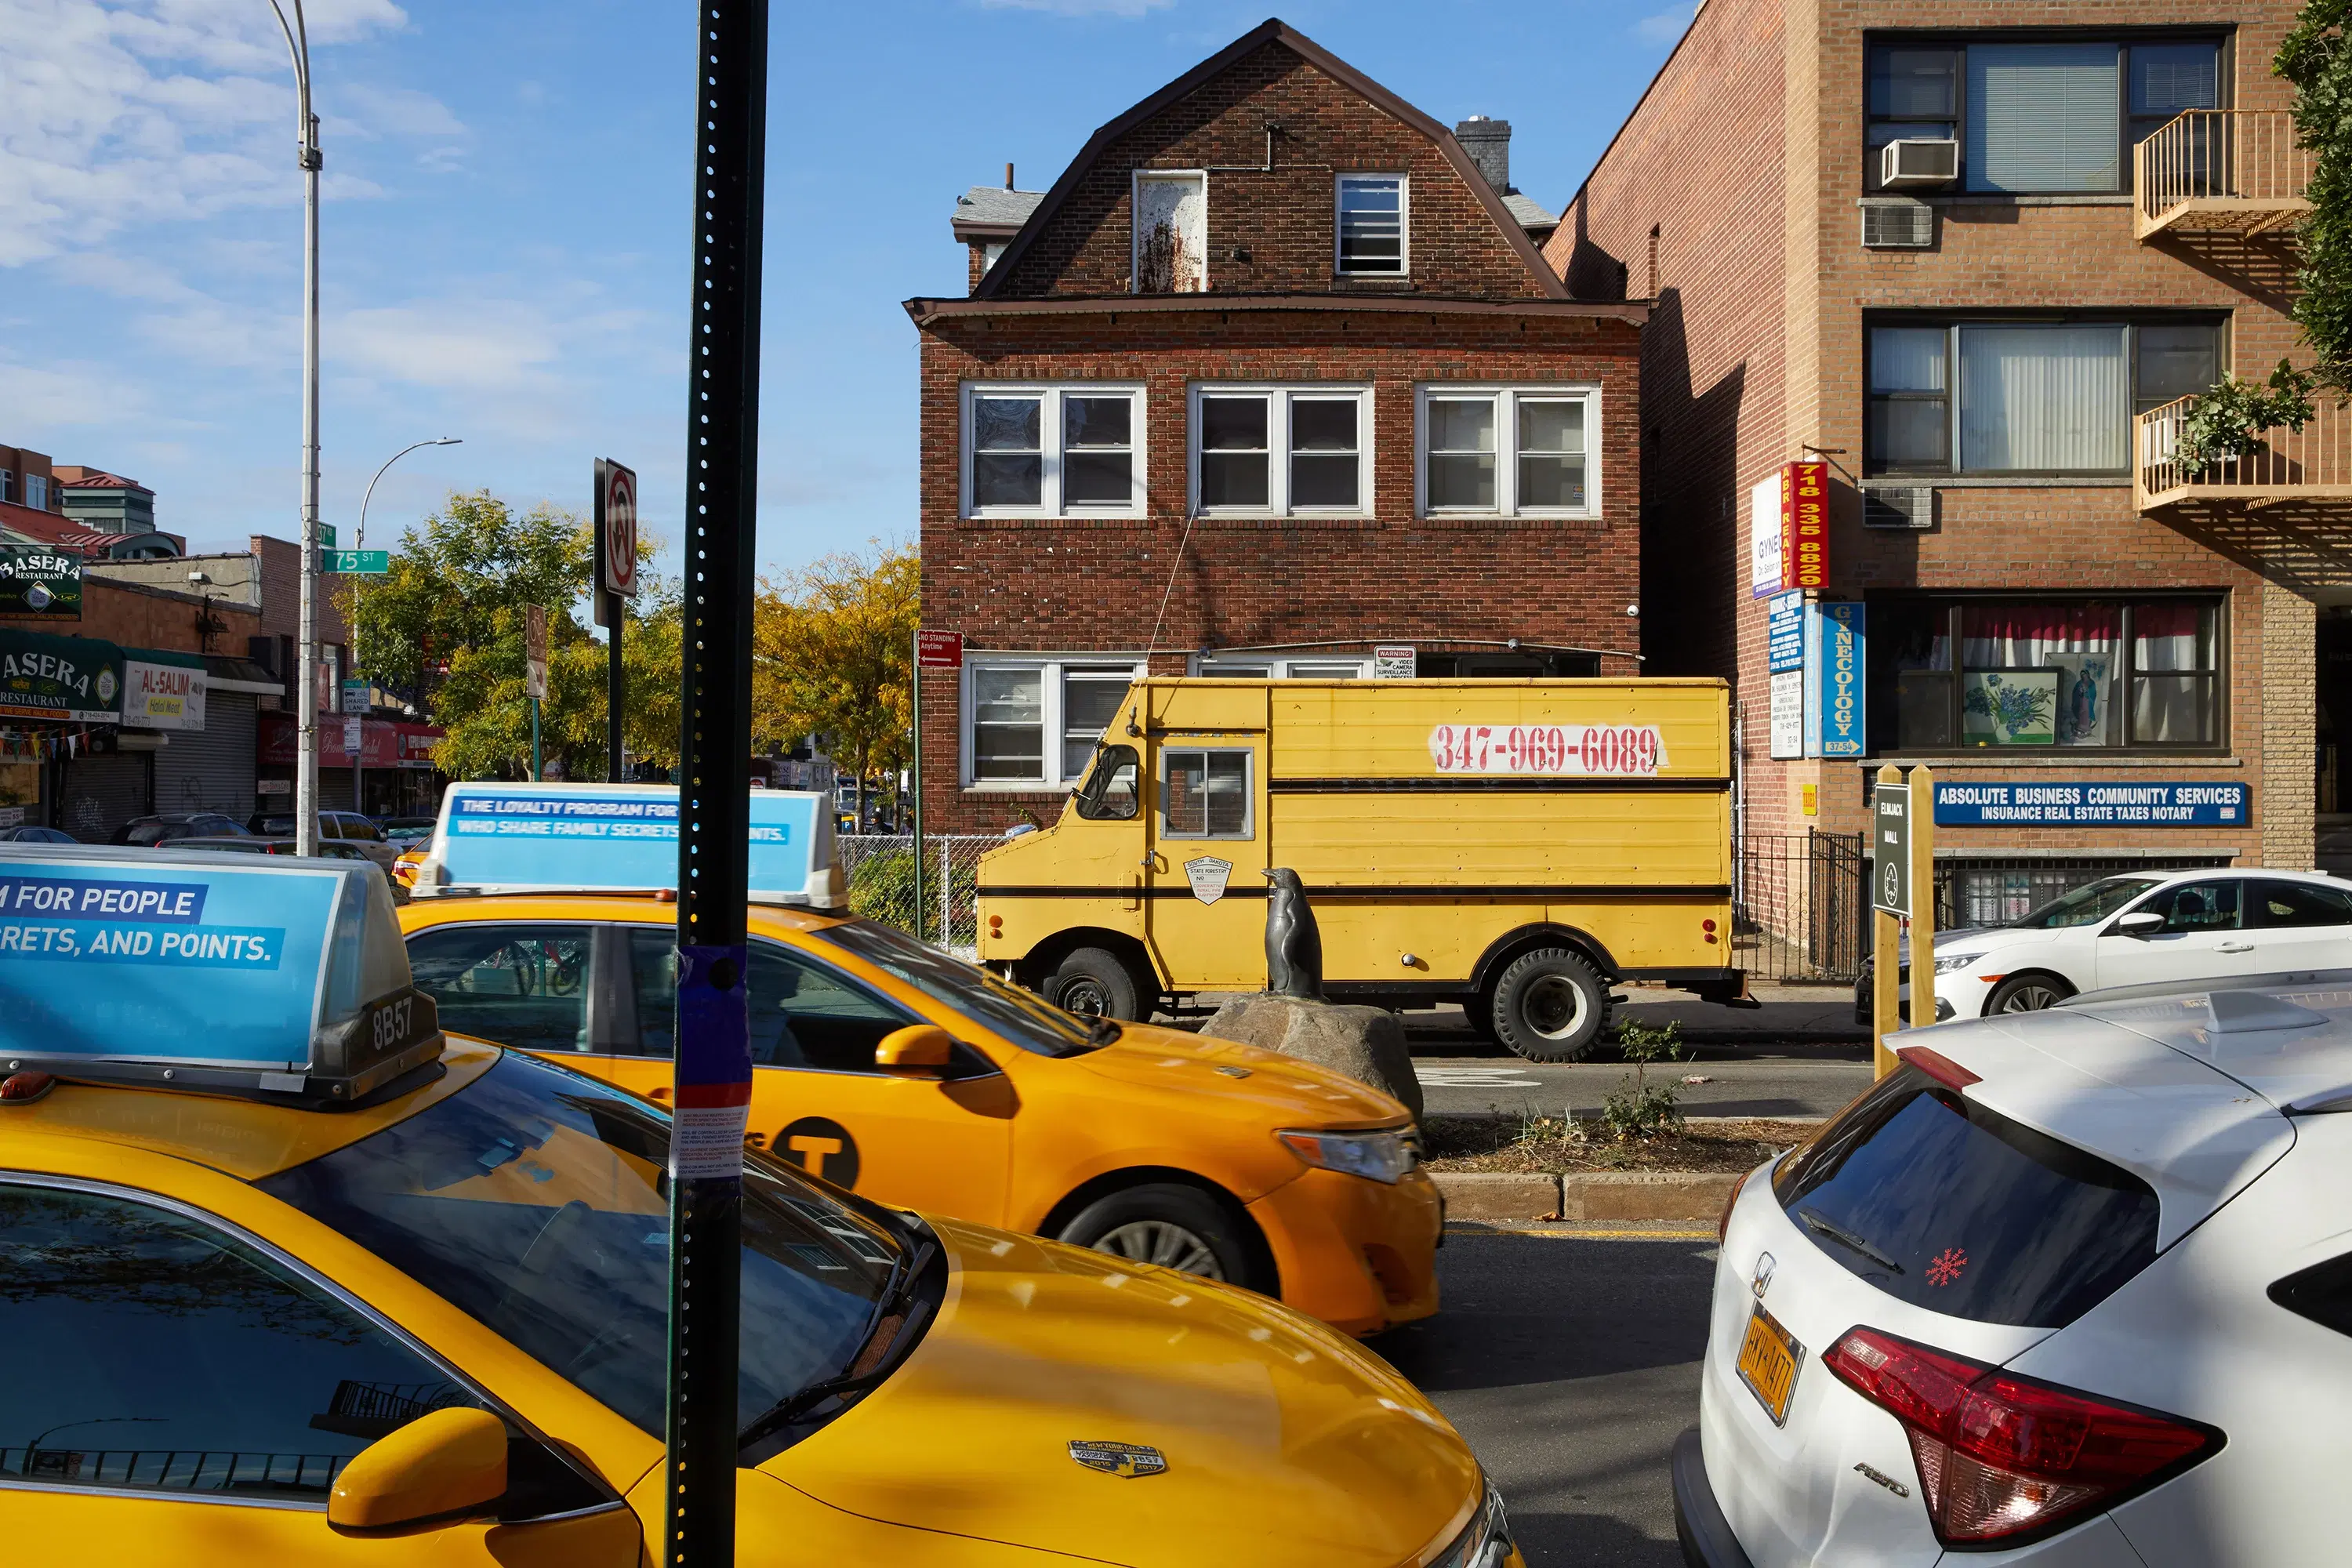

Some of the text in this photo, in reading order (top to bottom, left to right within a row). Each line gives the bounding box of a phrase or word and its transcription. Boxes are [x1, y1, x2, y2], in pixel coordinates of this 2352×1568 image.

[1782, 466, 1791, 587] ABR REALTY
[1798, 465, 1821, 586] 718 335 8829
[0, 555, 82, 580] BASERA
[333, 552, 375, 570] 75 ST
[920, 642, 943, 652] Anytime
[2, 652, 90, 699] ASERA
[1834, 606, 1854, 736] GYNECOLOGY
[141, 670, 190, 697] AL-SALIM
[0, 691, 67, 708] RESTAURANT
[165, 700, 180, 713] Meat
[14, 708, 32, 717] SERVE
[1436, 725, 1657, 773] 347-969-6089
[1829, 742, 1853, 751] 37-54
[1938, 787, 2241, 804] ABSOLUTE BUSINESS COMMUNITY SERVICES
[462, 800, 679, 818] THE LOYALTY PROGRAM FOR
[1881, 801, 1903, 817] ELMJACK
[1981, 806, 2194, 820] INSURANCE REAL ESTATE TAXES NOTARY
[458, 819, 498, 833] WHO
[498, 821, 552, 836] SHARE
[552, 822, 611, 837] FAMILY
[750, 827, 786, 841] NTS.
[1885, 829, 1898, 844] MALL
[1187, 858, 1229, 868] SOUTH DAKOTA
[15, 886, 195, 916] FOR PEOPLE
[88, 931, 154, 956] AND
[160, 931, 271, 961] POINTS.
[372, 996, 413, 1051] 8B57
[788, 1134, 843, 1177] T
[1764, 1311, 1790, 1348] NEW YORK
[1853, 1461, 1910, 1498] AWD
